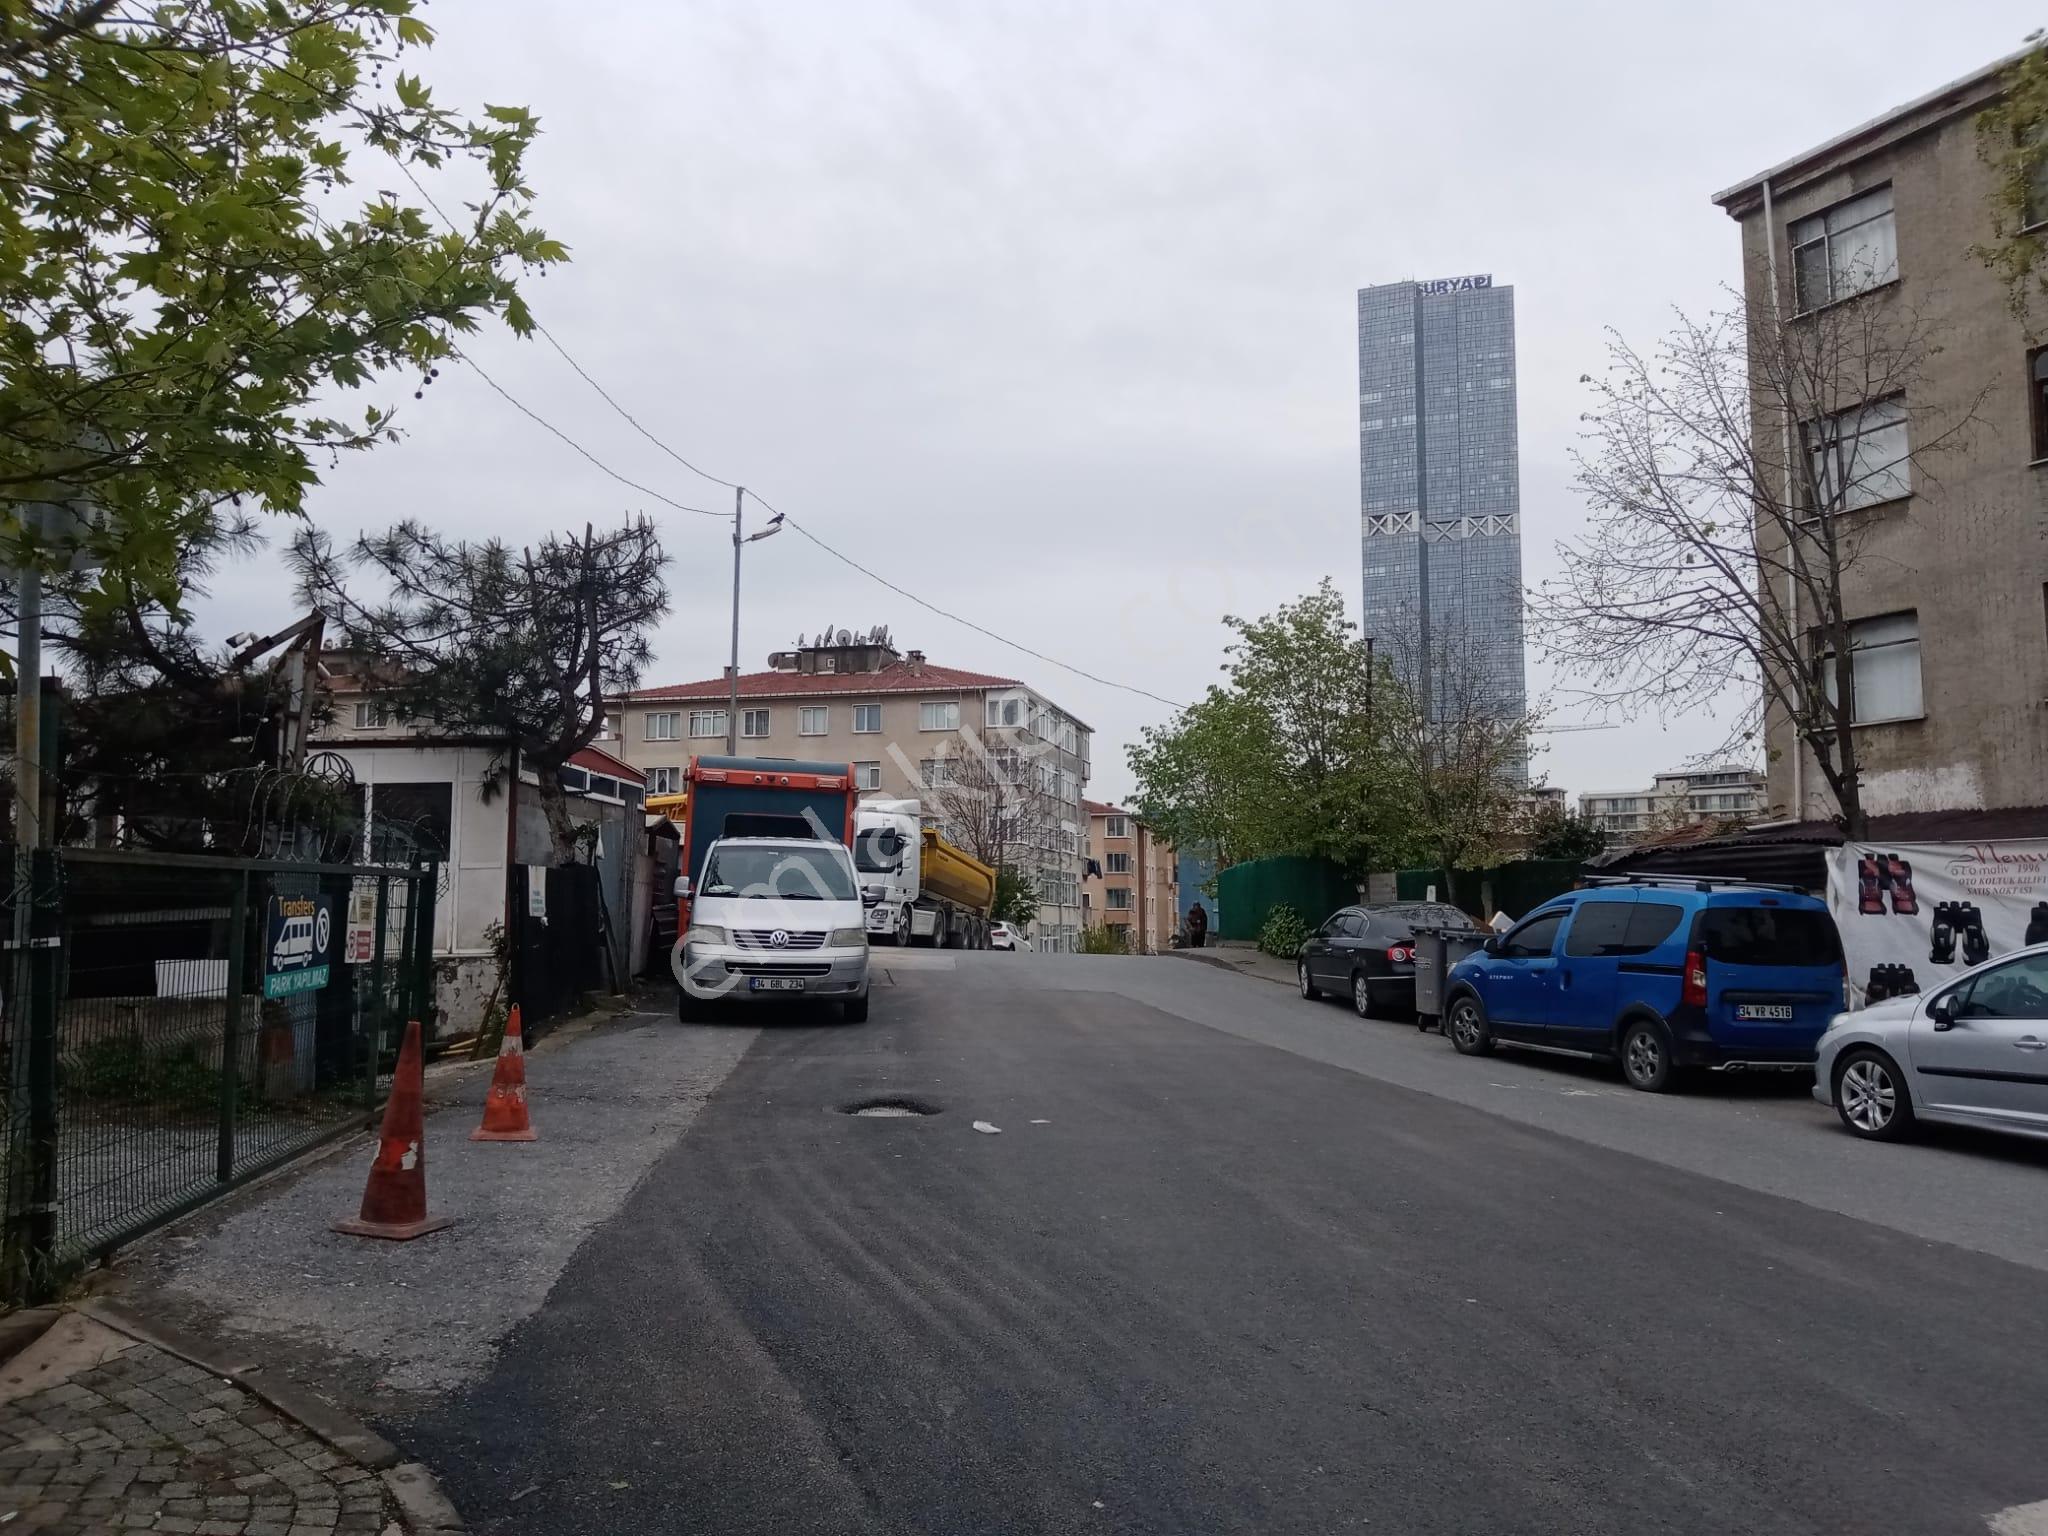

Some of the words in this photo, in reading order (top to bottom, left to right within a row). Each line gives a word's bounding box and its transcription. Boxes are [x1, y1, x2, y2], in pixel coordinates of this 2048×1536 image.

[2017, 864, 2041, 873] 1996
[1958, 878, 1977, 886] OTO
[1979, 877, 2015, 885] KOLTUK
[1967, 887, 1991, 896] SATIŞ
[278, 895, 316, 917] Transfers
[270, 974, 293, 995] PARK
[293, 968, 328, 990] YAPILMAZ
[1739, 1006, 1751, 1017] 34
[1769, 1006, 1791, 1018] 4516
